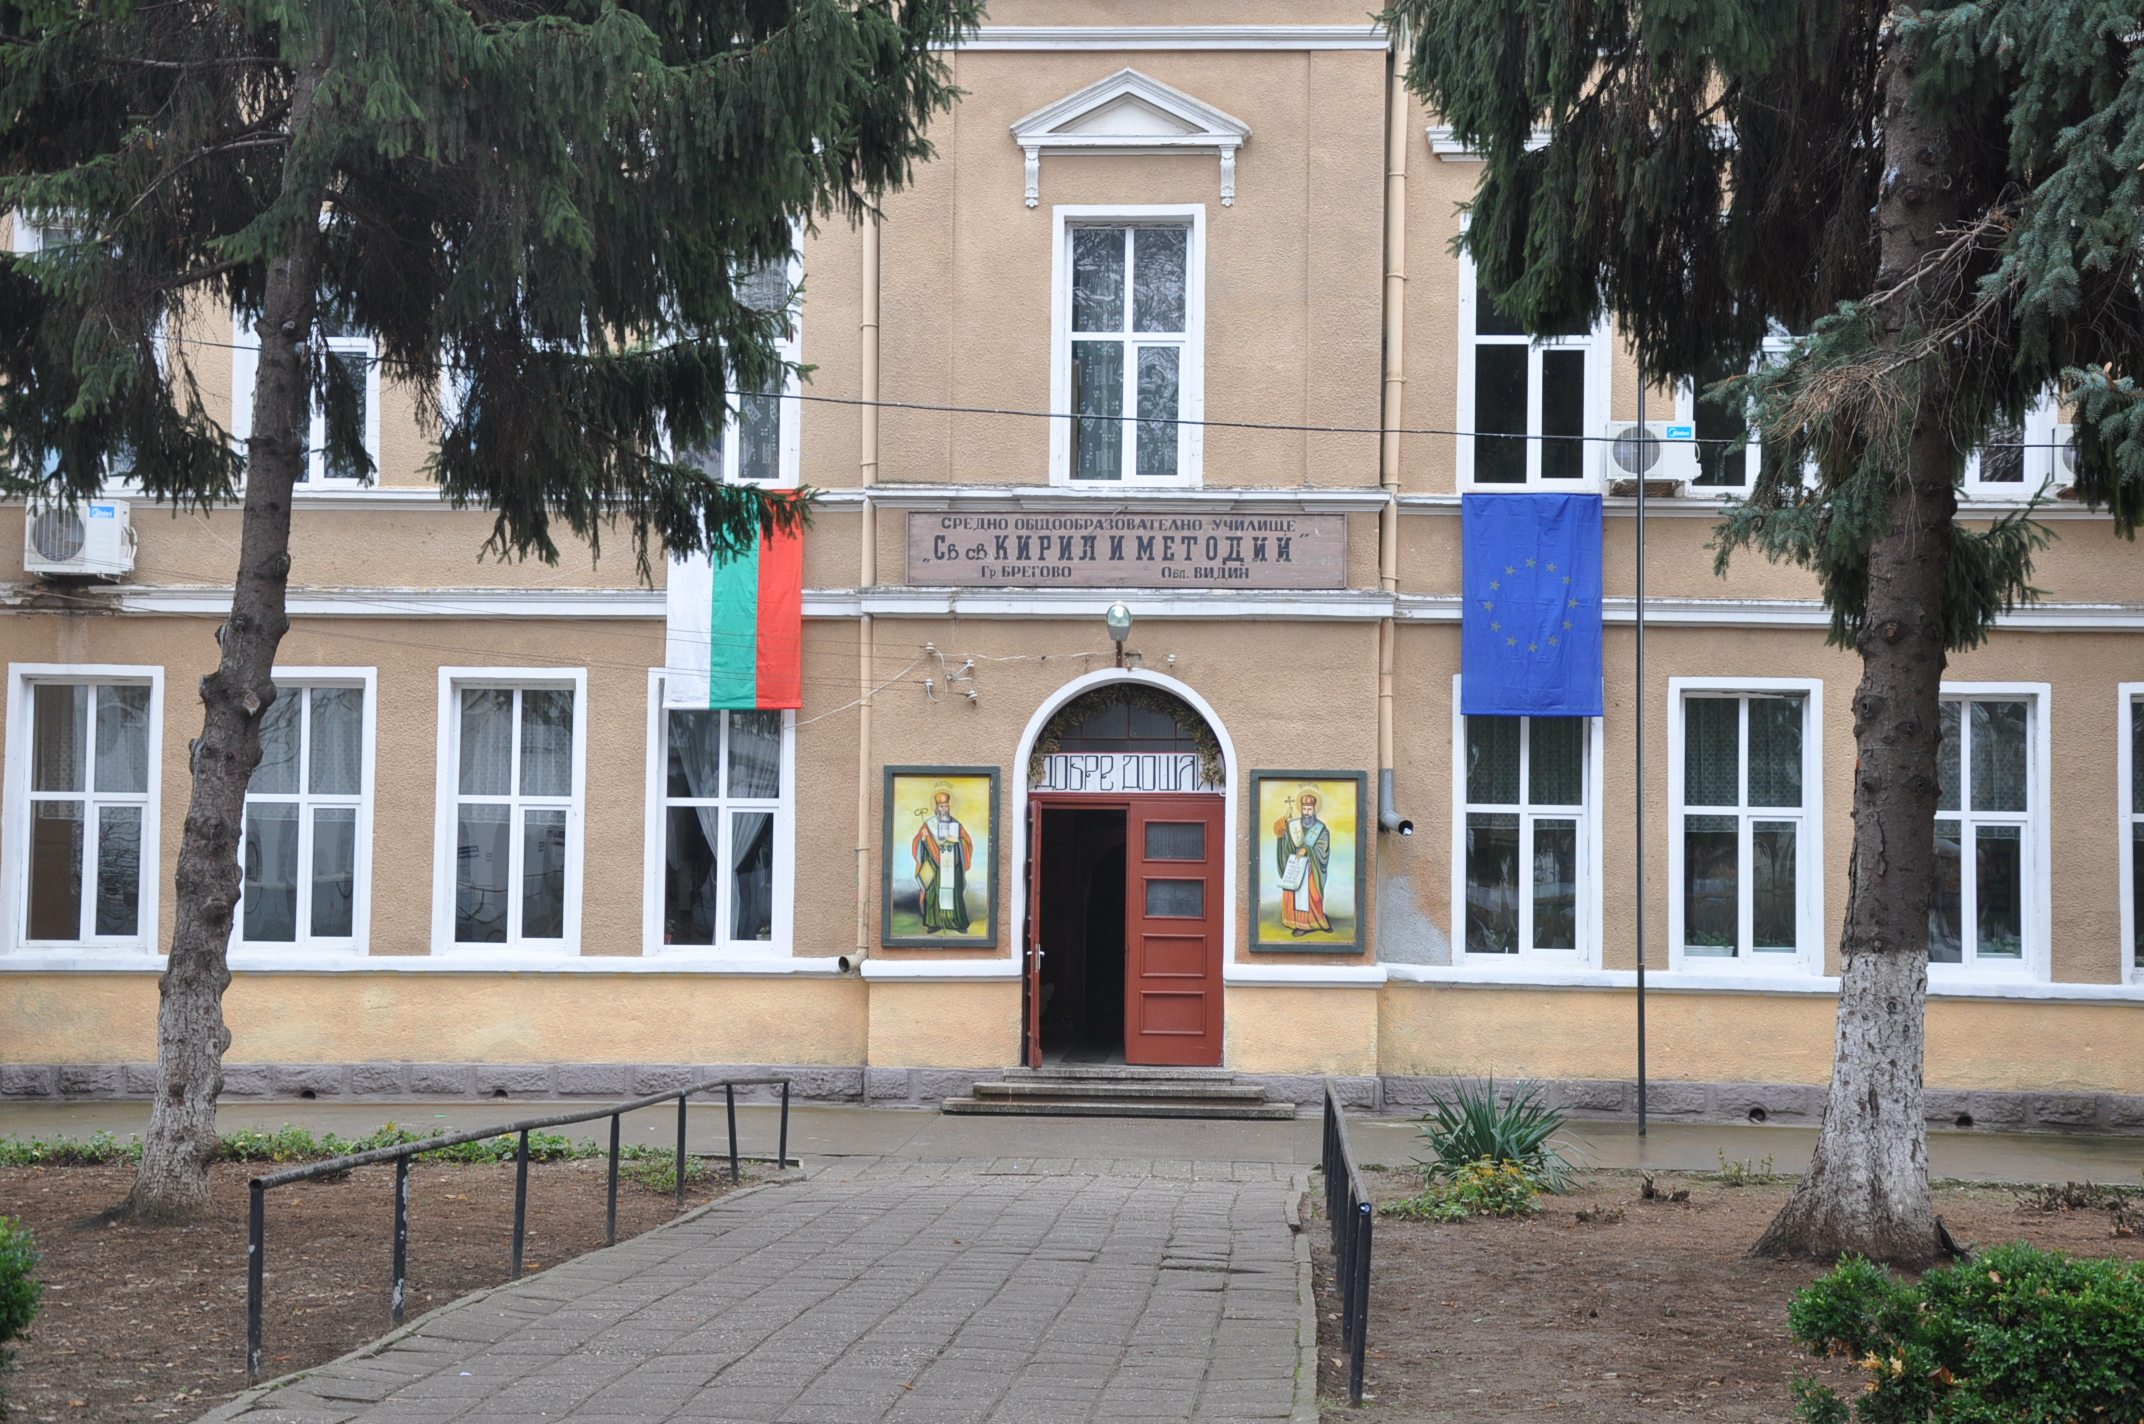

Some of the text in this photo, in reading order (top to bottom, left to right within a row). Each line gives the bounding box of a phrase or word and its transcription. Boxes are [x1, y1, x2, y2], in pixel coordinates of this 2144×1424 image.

[941, 517, 1297, 533] СРЕДНО ОБЩООБРАЗОВАТЕЛНО УЧИЛИЩЕ
[994, 534, 1097, 562] КИРИЛ
[1108, 534, 1125, 562] И
[1001, 565, 1072, 578] БРЕГОВО
[1194, 566, 1250, 580] ВИДИН
[1035, 755, 1114, 791] ДОБРЕ
